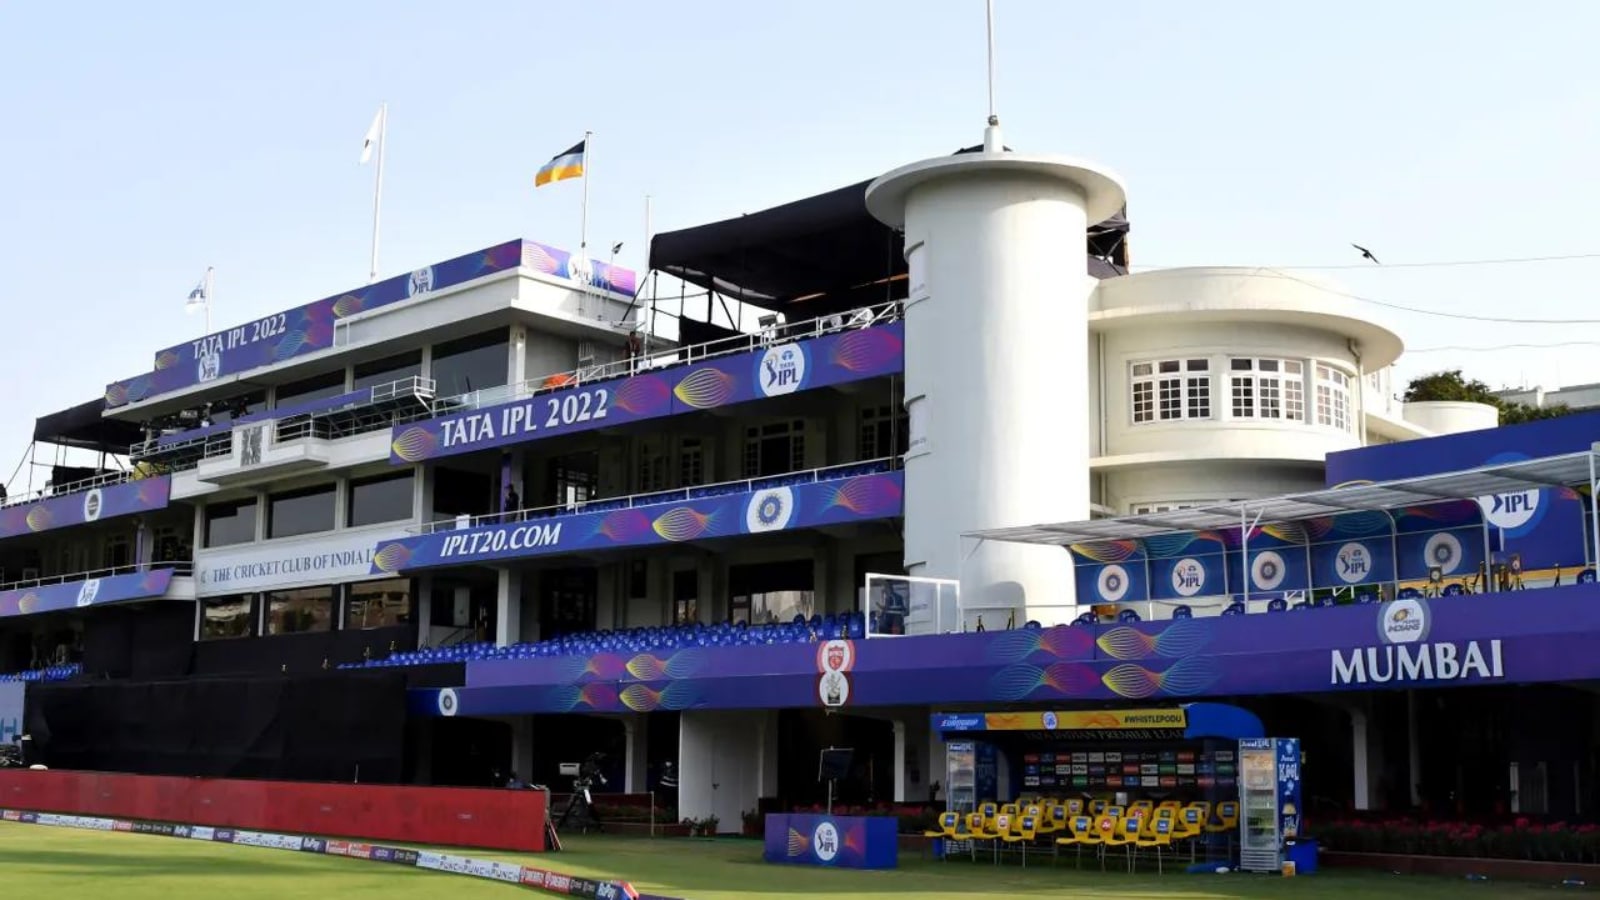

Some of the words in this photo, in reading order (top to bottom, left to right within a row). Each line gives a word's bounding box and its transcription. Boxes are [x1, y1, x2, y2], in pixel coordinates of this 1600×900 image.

[192, 334, 224, 360] TATA
[227, 327, 248, 350] IPL
[252, 313, 287, 342] 2022
[778, 367, 799, 386] IPL
[441, 412, 495, 447] TATA
[501, 403, 537, 436] IPL
[545, 388, 608, 428] 2022
[1504, 493, 1534, 513] IPL
[440, 522, 562, 557] IPLT20.COM
[213, 567, 232, 583] THE
[234, 560, 281, 580] CRICKET
[282, 556, 311, 574] CLUB
[313, 554, 329, 569] OF
[331, 550, 363, 568] INDIA
[1185, 576, 1201, 588] IPL
[1350, 562, 1367, 574] IPL
[1330, 639, 1504, 685] MUMBAI
